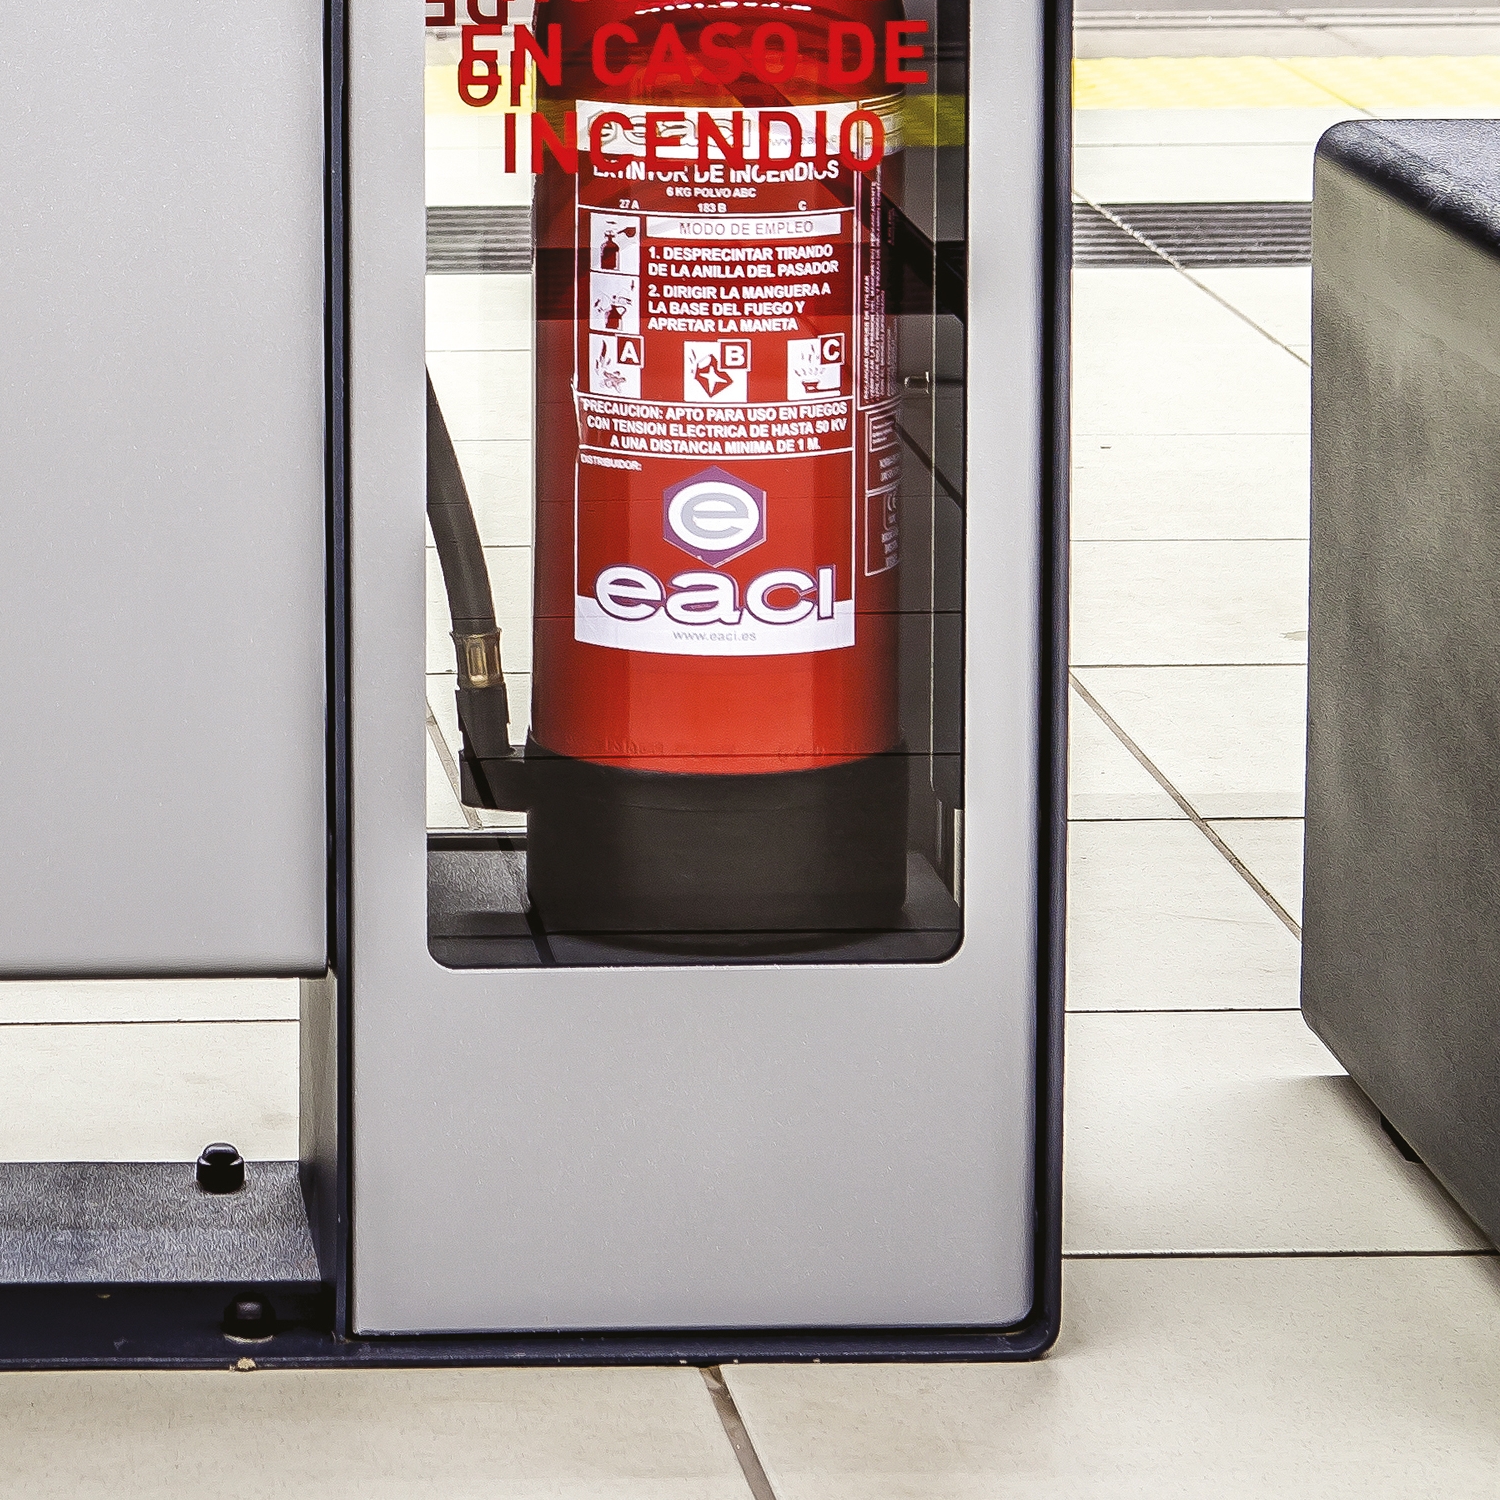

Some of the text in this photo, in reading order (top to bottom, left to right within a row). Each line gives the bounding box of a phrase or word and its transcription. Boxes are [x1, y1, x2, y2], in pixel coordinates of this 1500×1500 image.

[461, 22, 562, 86] EN
[592, 21, 800, 85] CASO
[829, 20, 929, 84] DE
[504, 109, 885, 174] INCENDIO
[666, 186, 757, 199] 6 KG POLVO ABC
[631, 200, 640, 210] A
[717, 203, 727, 213] B
[798, 200, 807, 211] C
[680, 220, 814, 236] MODO DE EMPLEO
[649, 244, 833, 262] 1. DESPRECINTAR TIRANDO
[648, 260, 839, 279] DE LA ANILLA DEL PASADOR
[648, 282, 831, 300] 2. DIRIGIR LA MANGUERA A
[648, 300, 806, 316] LA BASE DEL FUEGO Y
[648, 317, 799, 333] APRETAR LA MANETA
[620, 340, 640, 363] A
[724, 345, 745, 366] B
[822, 339, 841, 361] C
[583, 399, 847, 422] PRECAUCION: APTO PARA USO EN FUEGOS
[586, 415, 847, 438] CON TENSION ELECTRICA DE HASTA 50 KV
[609, 434, 619, 448] A
[621, 436, 649, 450] UNA
[650, 438, 722, 454] DISTANCIA
[724, 440, 774, 454] MINIMA
[776, 439, 795, 453] DE
[796, 438, 804, 451] 1
[580, 453, 642, 471] DISTRIBUIDOR:
[680, 492, 749, 539] e
[594, 564, 836, 626] eaci
[672, 630, 757, 641] www.eaci.es
